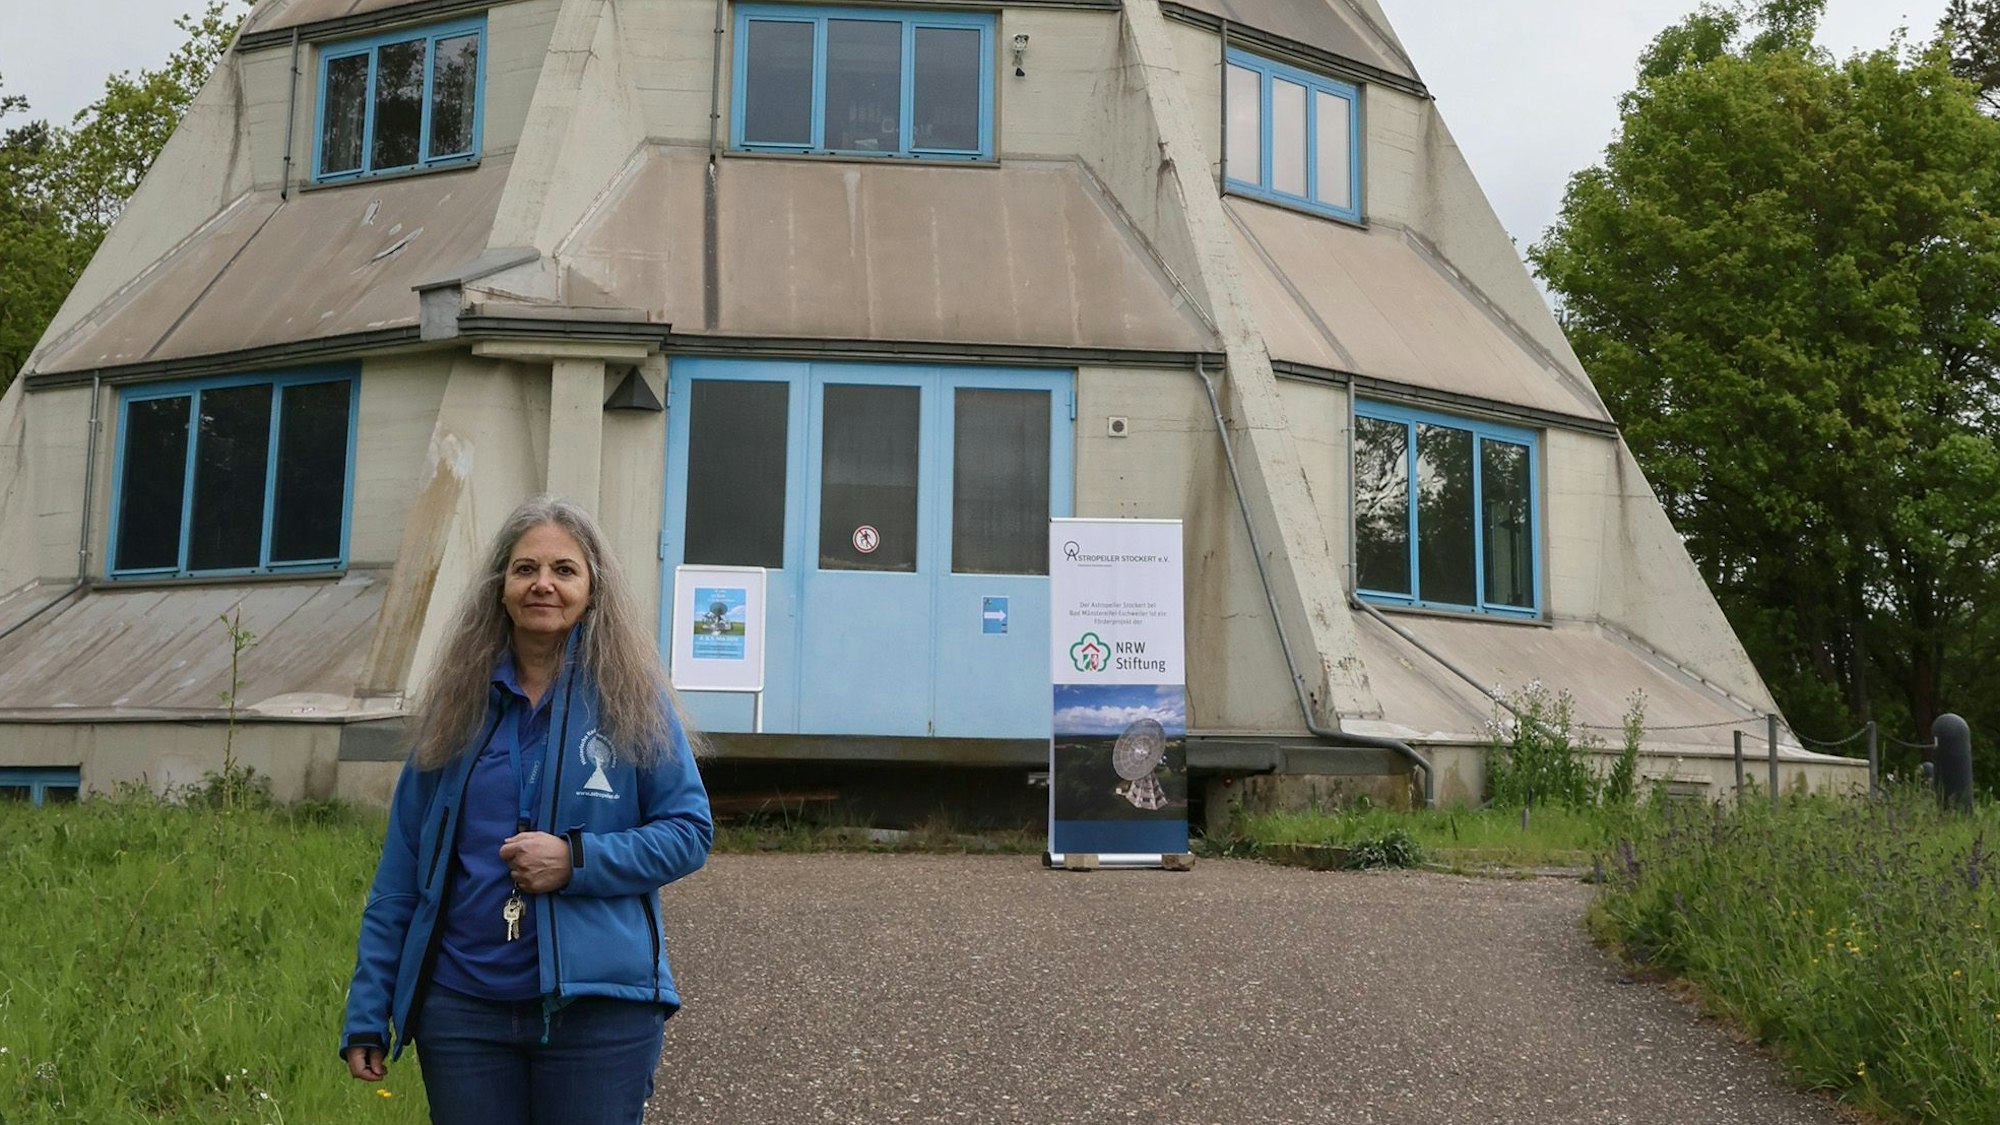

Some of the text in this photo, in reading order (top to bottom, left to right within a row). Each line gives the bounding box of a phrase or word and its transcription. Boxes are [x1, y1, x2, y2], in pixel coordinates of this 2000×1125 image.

[1121, 554, 1157, 562] STOCKERT
[1115, 641, 1146, 654] NRW
[1115, 656, 1166, 673] Stiftung
